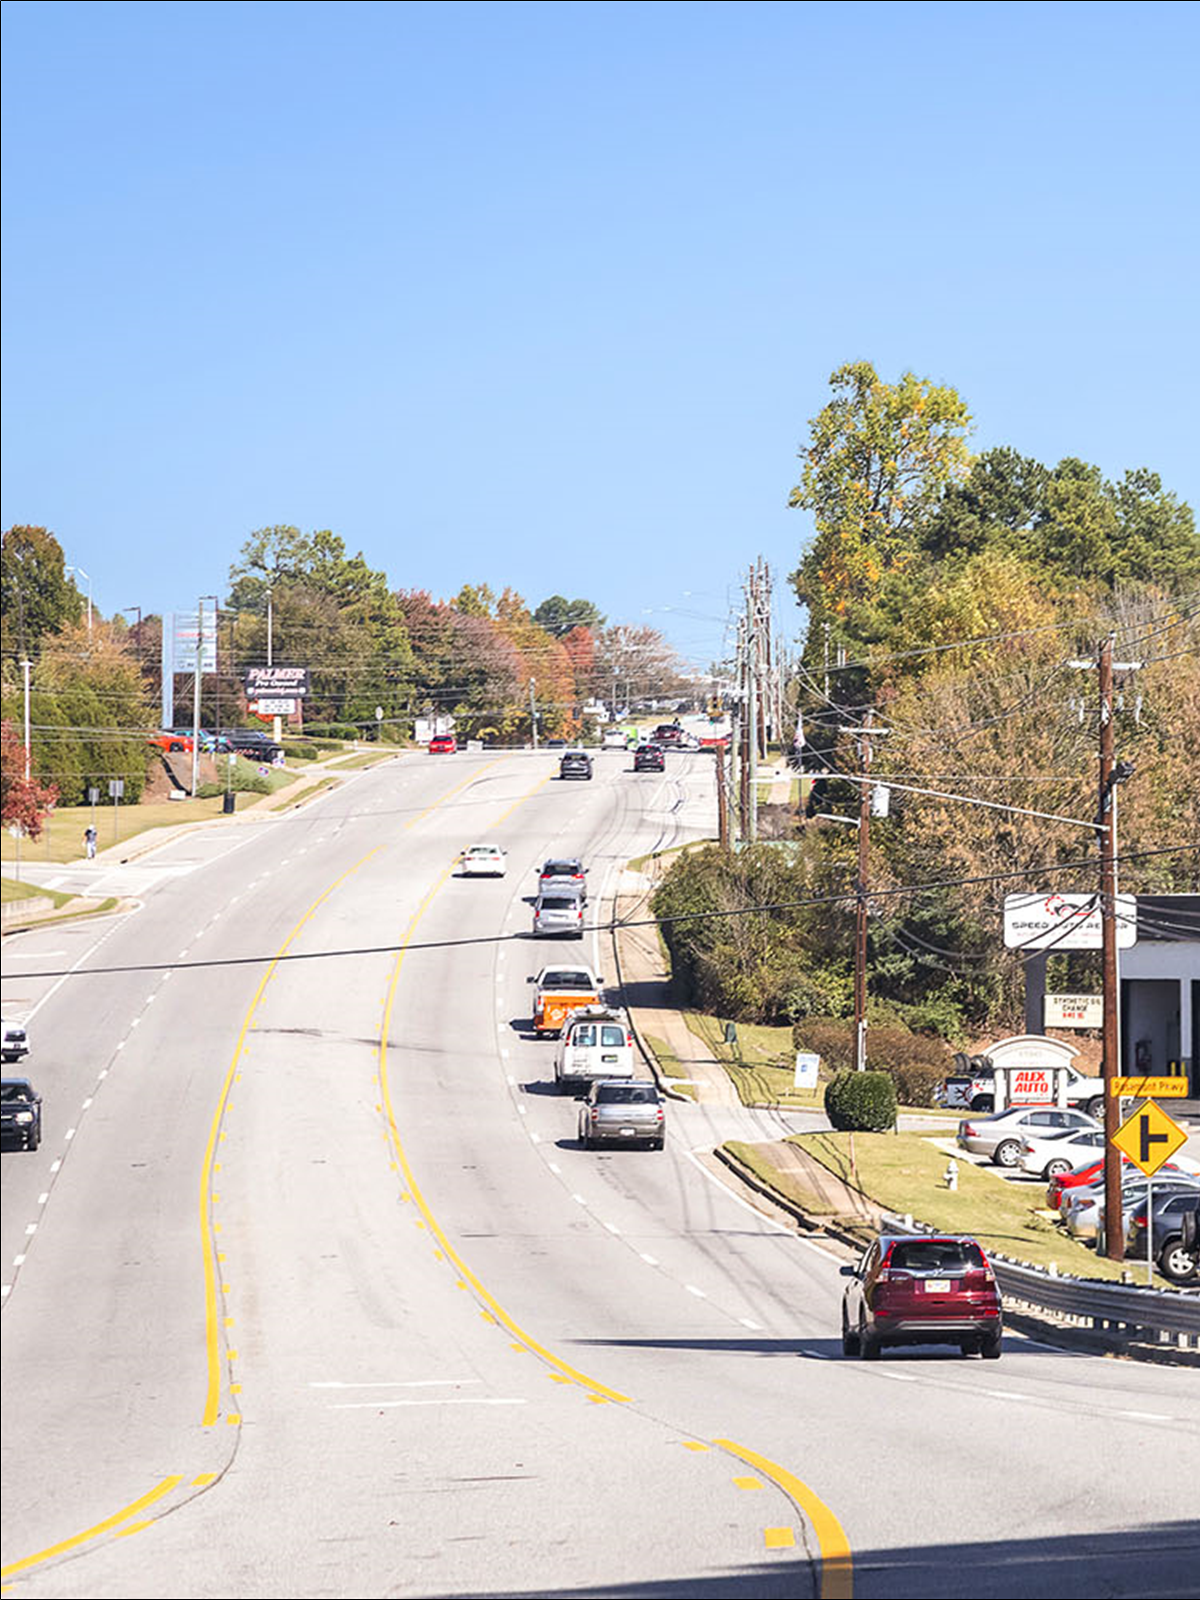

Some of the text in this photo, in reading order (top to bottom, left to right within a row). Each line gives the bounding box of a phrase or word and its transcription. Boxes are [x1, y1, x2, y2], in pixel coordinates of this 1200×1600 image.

[247, 668, 306, 680] PALMER
[1011, 921, 1049, 929] SPEED
[1014, 1071, 1046, 1082] ALEX
[1013, 1082, 1049, 1093] AUTO
